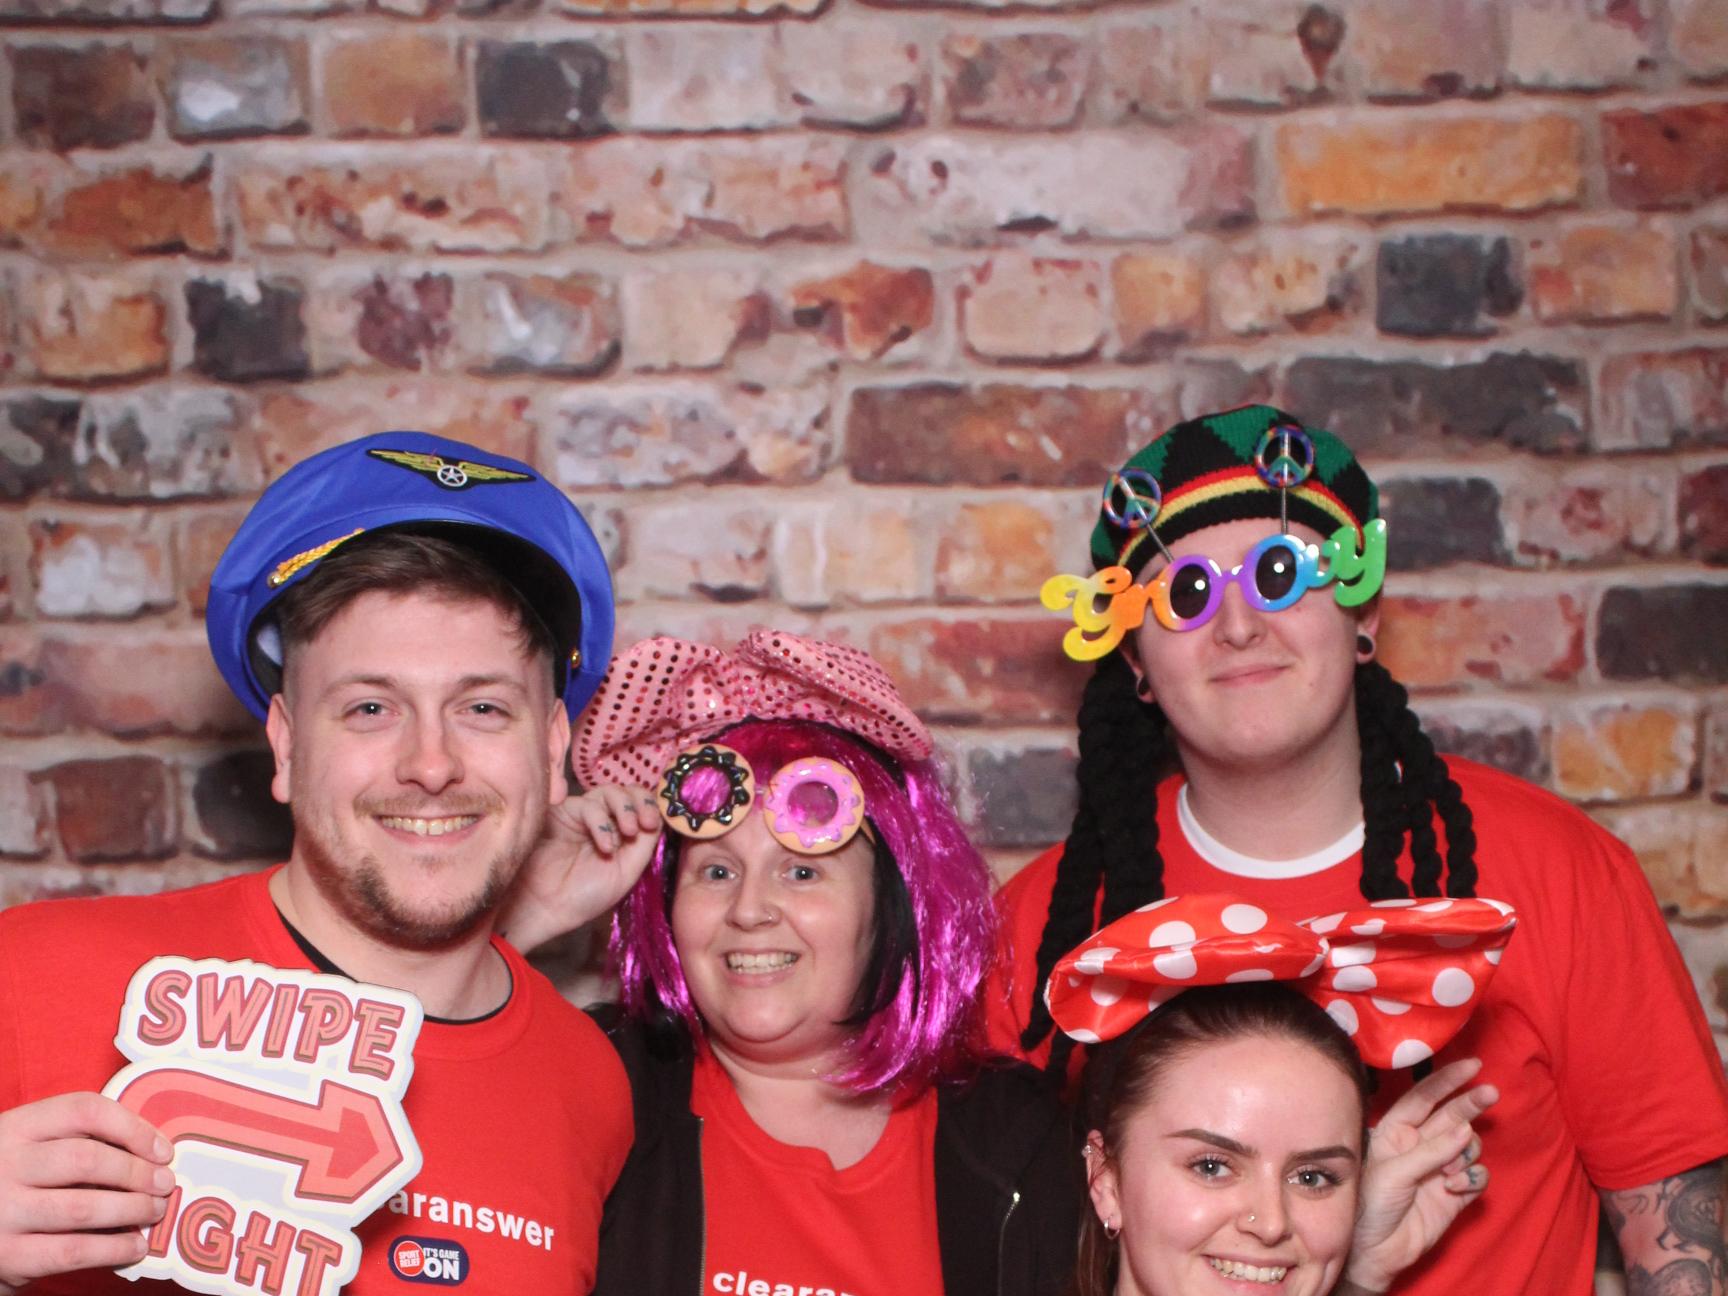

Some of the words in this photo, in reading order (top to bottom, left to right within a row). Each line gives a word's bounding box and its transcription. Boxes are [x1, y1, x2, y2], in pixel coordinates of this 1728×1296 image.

[138, 969, 405, 1081] SWIPE
[378, 1189, 554, 1251] aranswer
[423, 1257, 460, 1281] ON
[439, 1248, 460, 1260] GAME
